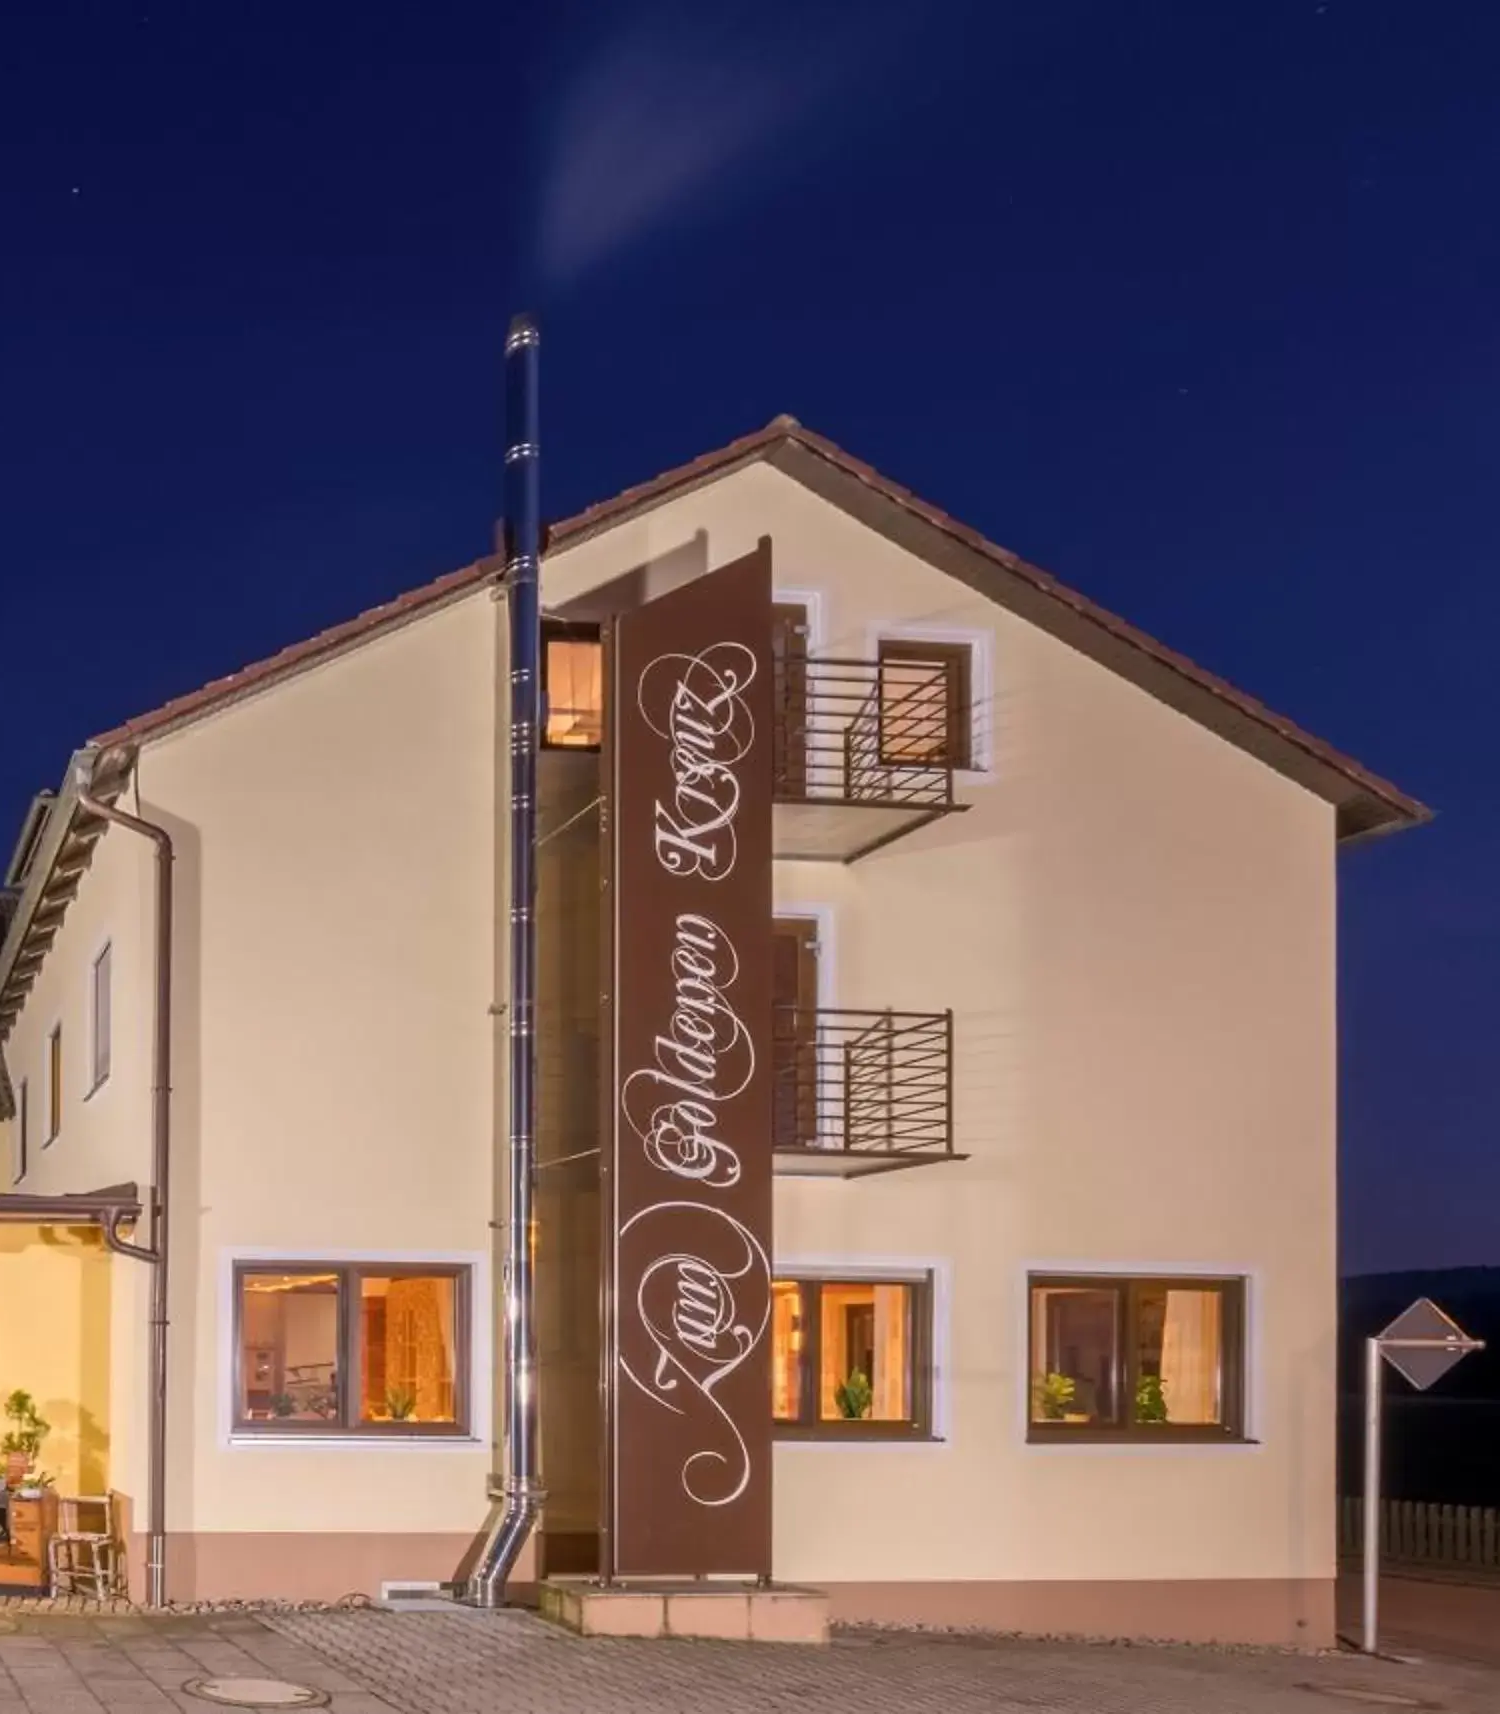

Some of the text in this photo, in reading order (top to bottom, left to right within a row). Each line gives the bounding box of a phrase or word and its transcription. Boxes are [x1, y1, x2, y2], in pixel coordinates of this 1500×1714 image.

[619, 641, 771, 1506] Zum Goldenen Kreuz
